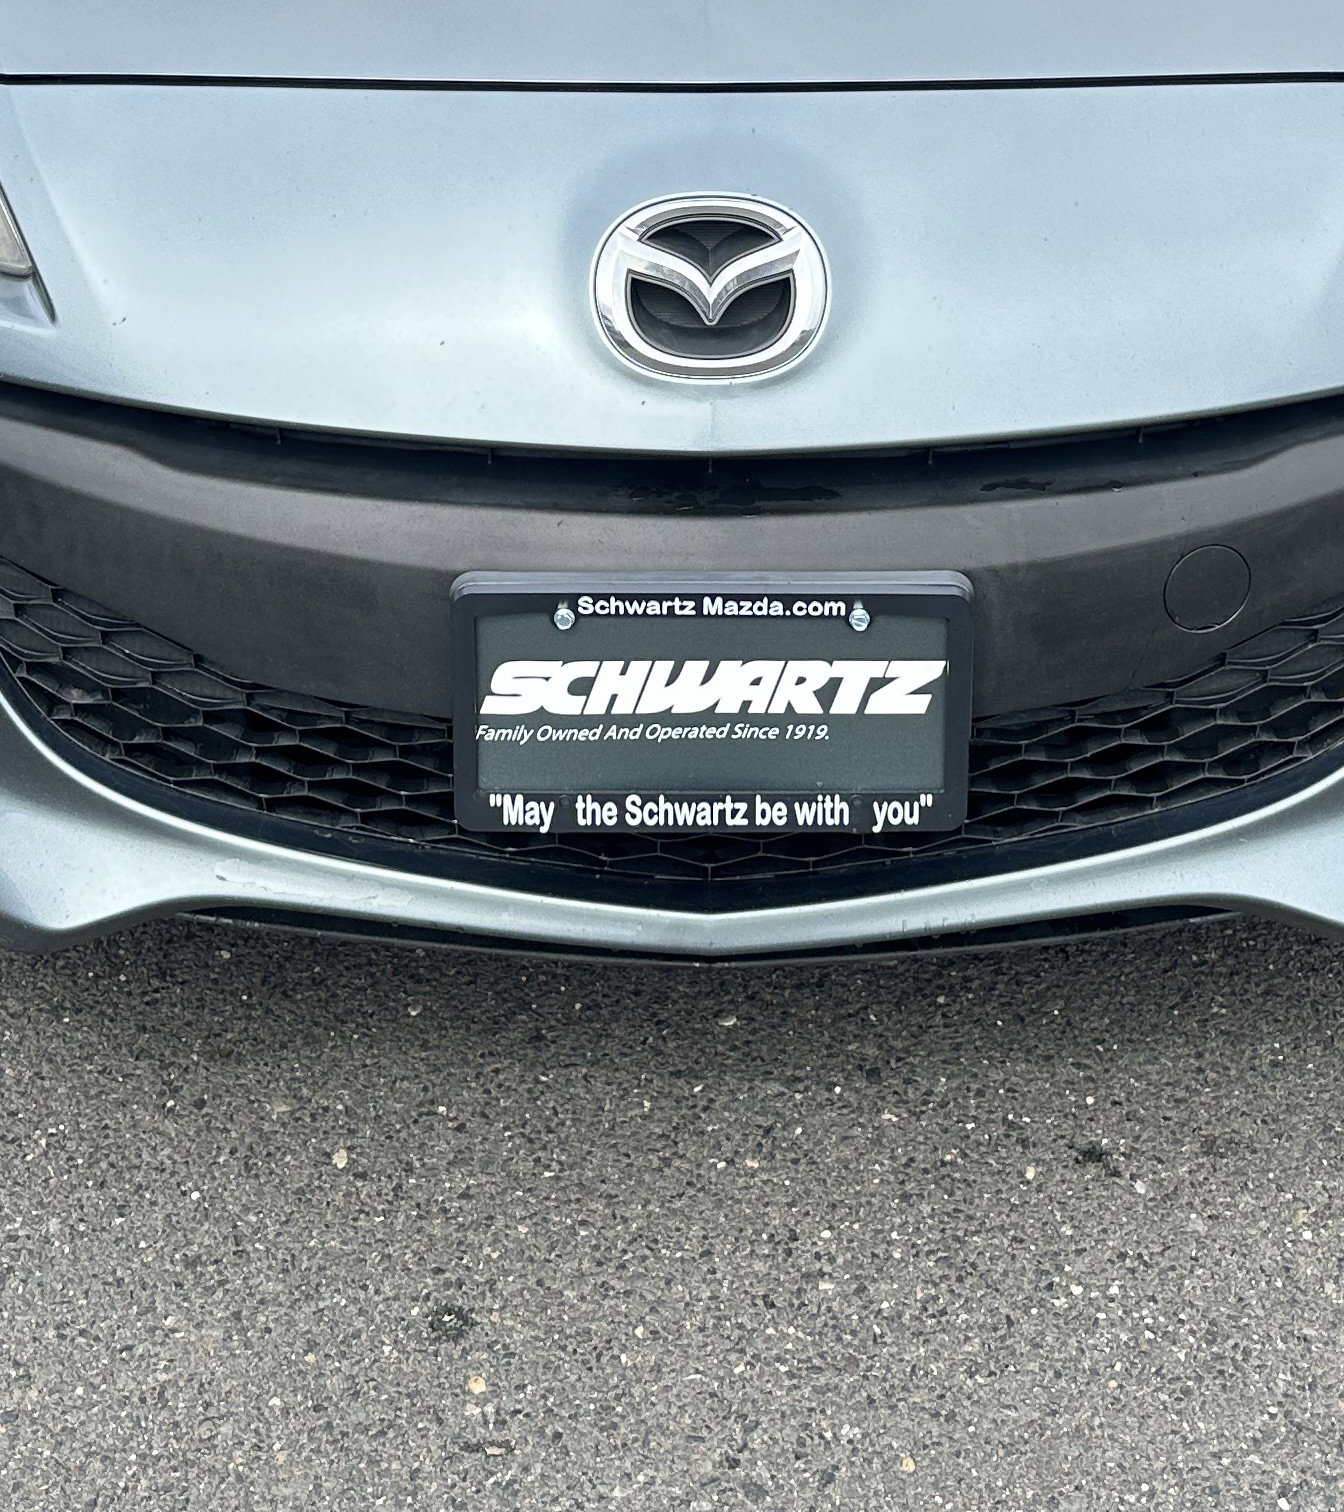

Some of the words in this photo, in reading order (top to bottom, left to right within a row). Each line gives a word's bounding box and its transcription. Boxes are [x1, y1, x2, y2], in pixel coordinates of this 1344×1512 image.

[577, 596, 696, 616] Schwartz
[702, 596, 847, 617] Mazda.com
[479, 660, 947, 715] SCHWARTZ
[475, 724, 534, 745] Family
[536, 724, 601, 742] Owned
[603, 724, 643, 740] And
[645, 723, 730, 743] Operated
[731, 723, 780, 740] Since
[784, 724, 830, 740] 1919.
[489, 793, 555, 834] "May
[575, 794, 618, 826] the
[624, 794, 749, 827] Schwartz
[755, 794, 788, 826] be
[793, 794, 850, 826] with
[872, 793, 934, 834] you"
